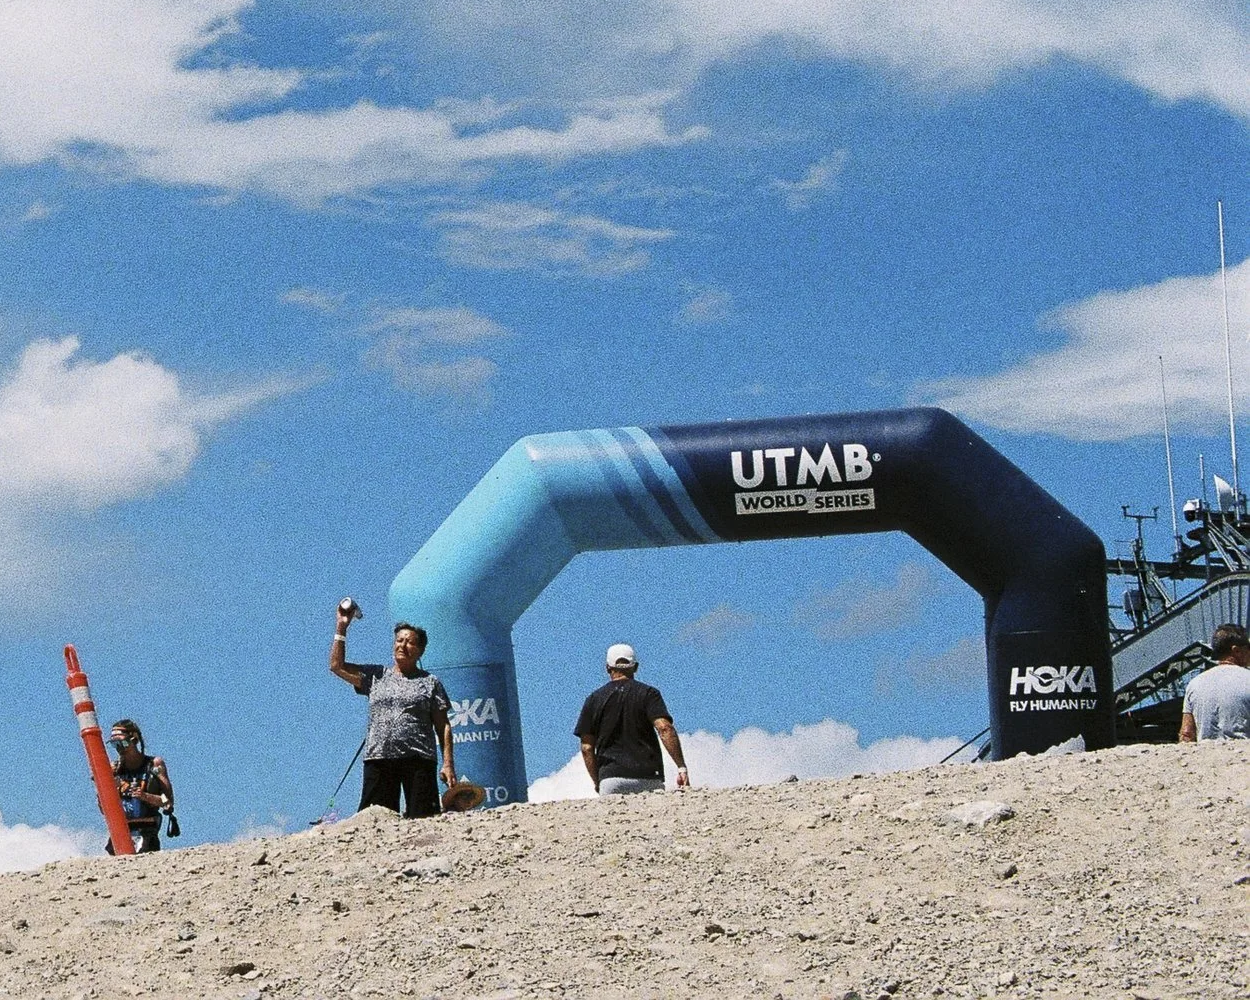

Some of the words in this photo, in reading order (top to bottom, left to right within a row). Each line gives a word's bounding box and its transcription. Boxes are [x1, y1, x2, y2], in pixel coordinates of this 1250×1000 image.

[741, 494, 807, 510] WORLD
[815, 493, 870, 509] SERIES
[1010, 666, 1097, 695] HOKA
[1010, 702, 1028, 712] FLY
[1030, 700, 1078, 711] HUMAN
[1080, 700, 1097, 710] FLY
[453, 732, 482, 743] MAN
[483, 730, 501, 741] FLY
